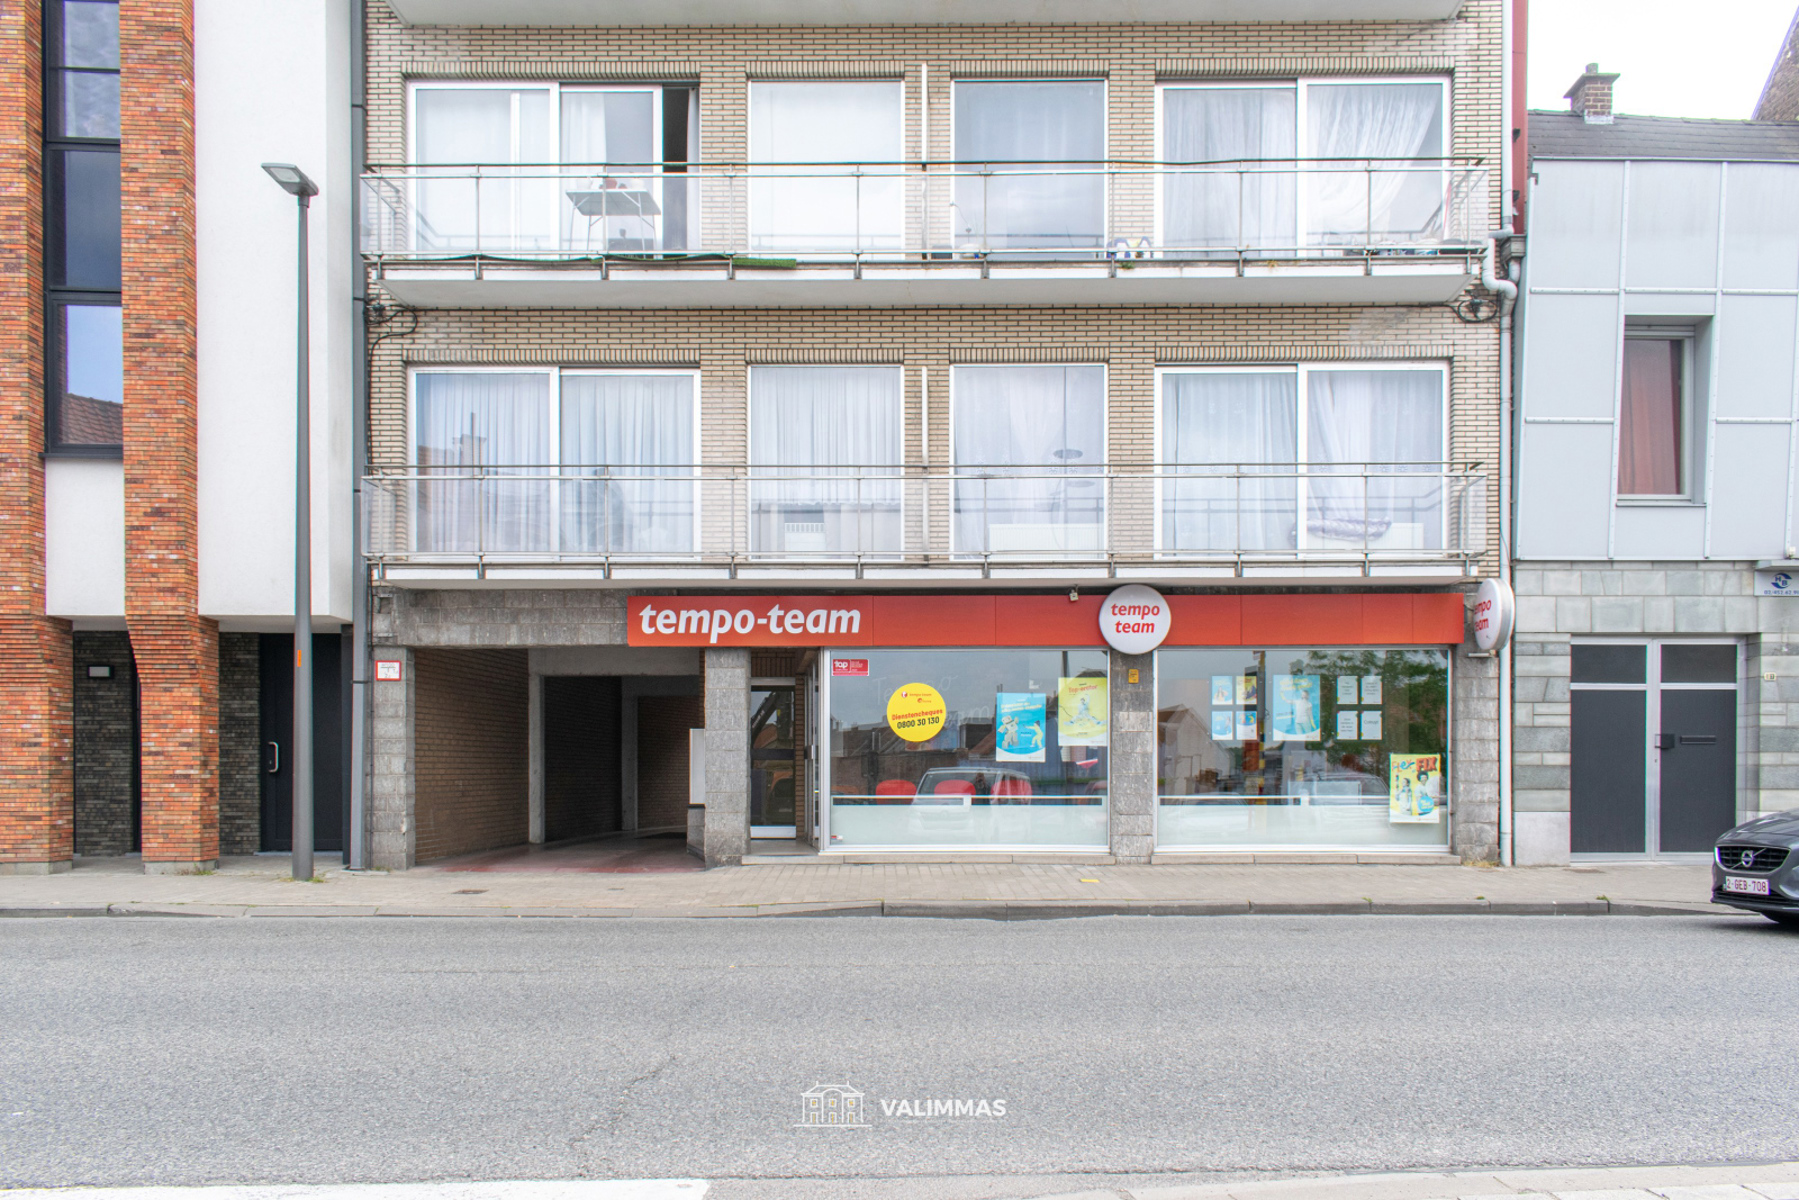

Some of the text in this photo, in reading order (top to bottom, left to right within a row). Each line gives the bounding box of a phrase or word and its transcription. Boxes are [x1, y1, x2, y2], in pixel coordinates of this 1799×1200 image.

[1111, 603, 1160, 620] tempo
[638, 603, 861, 644] tempo-team
[1114, 620, 1155, 633] team
[891, 708, 943, 721] Dienstencheques
[897, 716, 940, 729] 0800 30 130
[1416, 756, 1438, 772] FIX
[1726, 878, 1767, 892] 2-GEB-708
